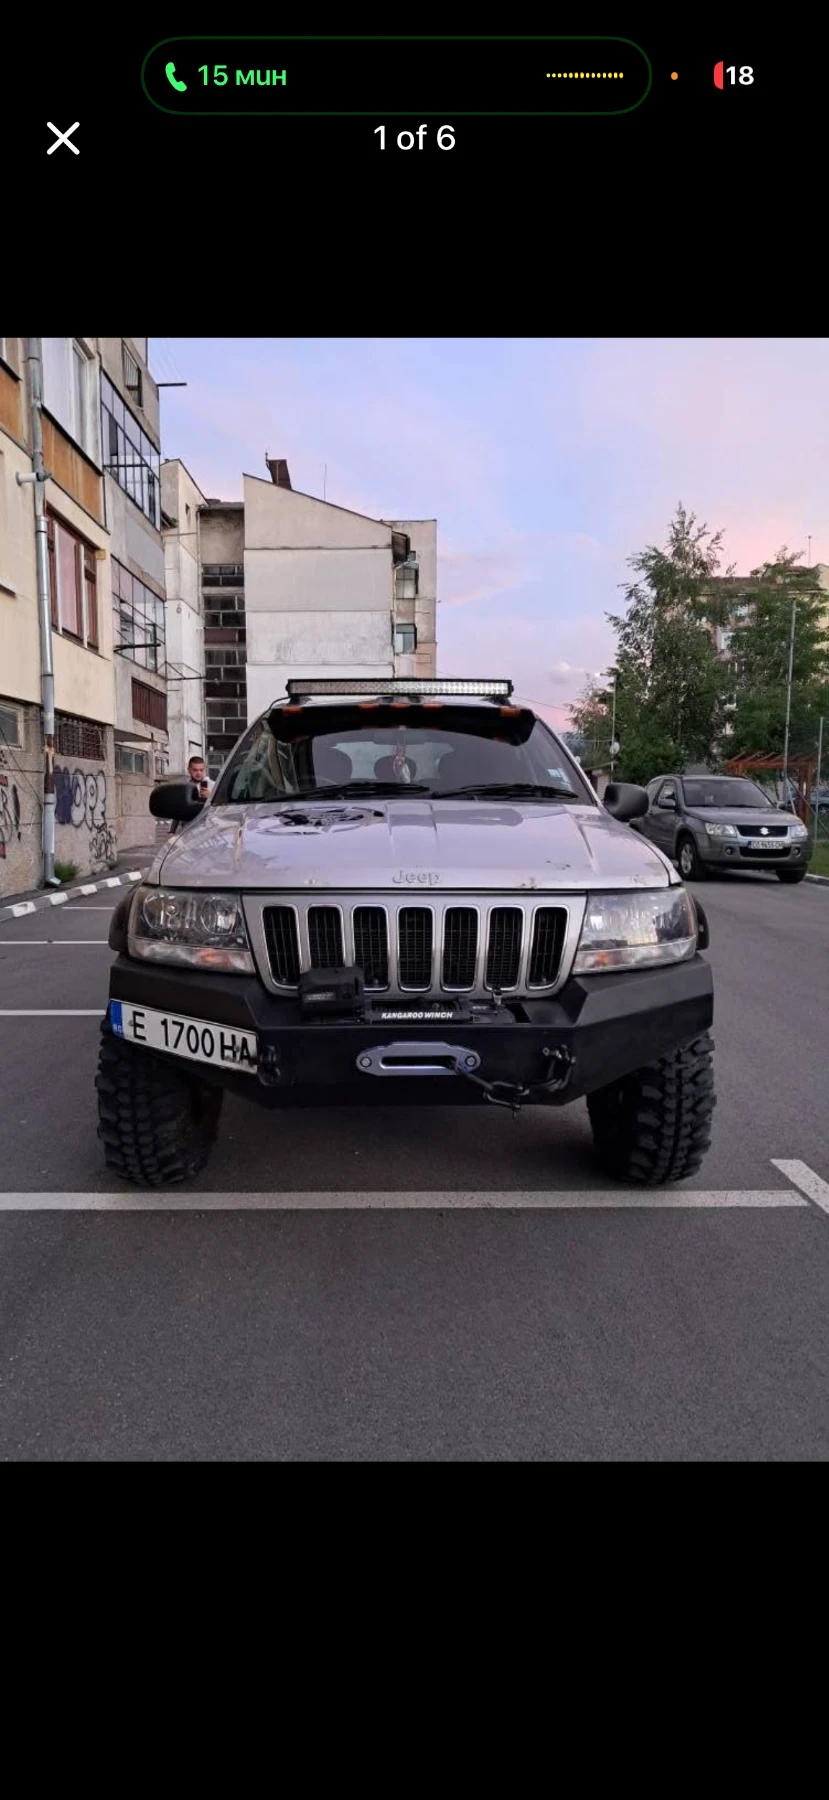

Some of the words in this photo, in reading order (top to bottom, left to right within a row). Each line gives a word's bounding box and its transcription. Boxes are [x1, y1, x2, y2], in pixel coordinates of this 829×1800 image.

[391, 869, 440, 886] Jeep
[132, 1010, 147, 1041] E
[160, 1018, 215, 1058] 1700
[219, 1031, 252, 1065] HA
